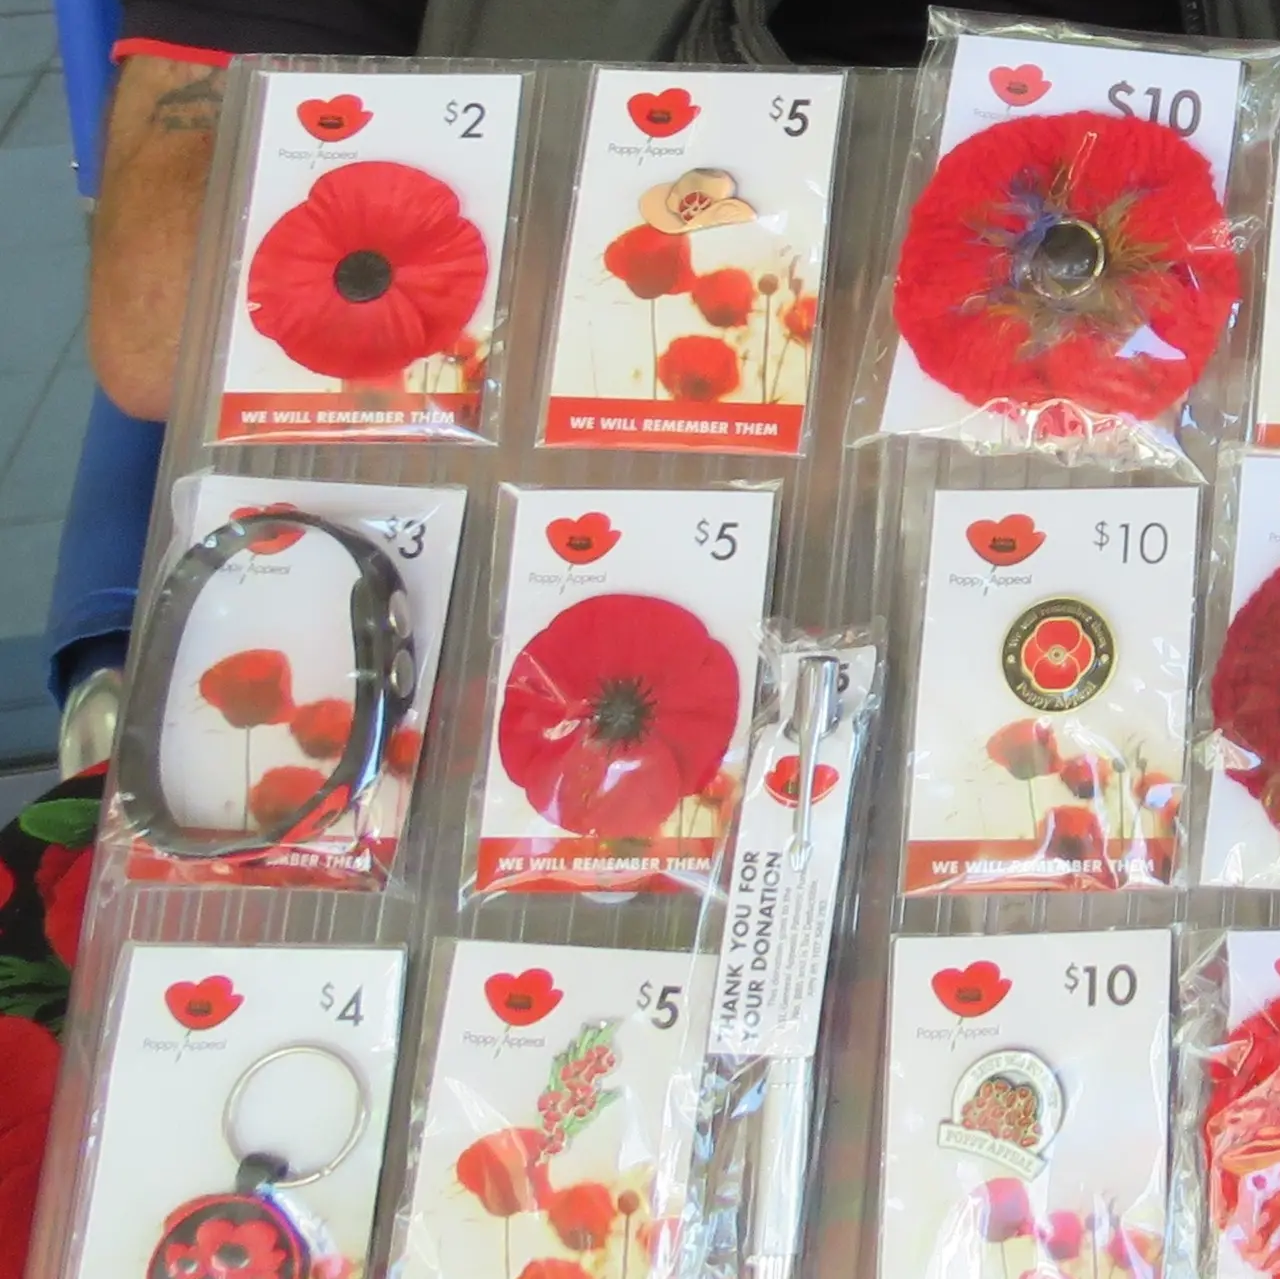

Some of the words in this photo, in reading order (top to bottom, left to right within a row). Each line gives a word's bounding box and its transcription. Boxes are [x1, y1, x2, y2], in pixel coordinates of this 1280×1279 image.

[444, 101, 485, 138] $2
[770, 95, 810, 137] $5
[1108, 81, 1200, 138] $10
[279, 149, 317, 161] Poppy
[321, 147, 358, 159] Appeal
[609, 144, 647, 156] Poppy
[648, 144, 683, 156] Appeal
[242, 410, 266, 424] WE
[273, 410, 311, 424] WILL
[317, 411, 405, 425] REMEMBER
[411, 411, 455, 426] THEM
[570, 417, 594, 430] WE
[600, 417, 638, 432] WILL
[644, 419, 730, 435] REMEMBER
[735, 421, 778, 436] THEM
[384, 516, 426, 560] $3
[694, 518, 738, 561] $5
[1093, 522, 1169, 564] $10
[949, 574, 984, 587] Poppy
[988, 574, 1032, 586] Appeal
[499, 858, 522, 871] WE
[528, 858, 566, 871] WILL
[572, 858, 659, 871] REMEMBER
[665, 858, 710, 871] THEM
[739, 851, 760, 893] FOR
[932, 859, 958, 873] WE
[965, 859, 998, 873] WILL
[1108, 859, 1154, 874] THEM
[730, 905, 752, 953] YOU
[751, 852, 783, 971] DONATION
[320, 984, 364, 1026] $4
[636, 981, 680, 1029] $5
[717, 964, 744, 1042] THANK
[1064, 963, 1136, 1008] $10
[742, 980, 765, 1041] YOUR
[463, 1031, 496, 1044] Poppy
[502, 1035, 545, 1048] Appeal
[917, 1027, 953, 1039] Poppy
[956, 1027, 1000, 1038] Appeal
